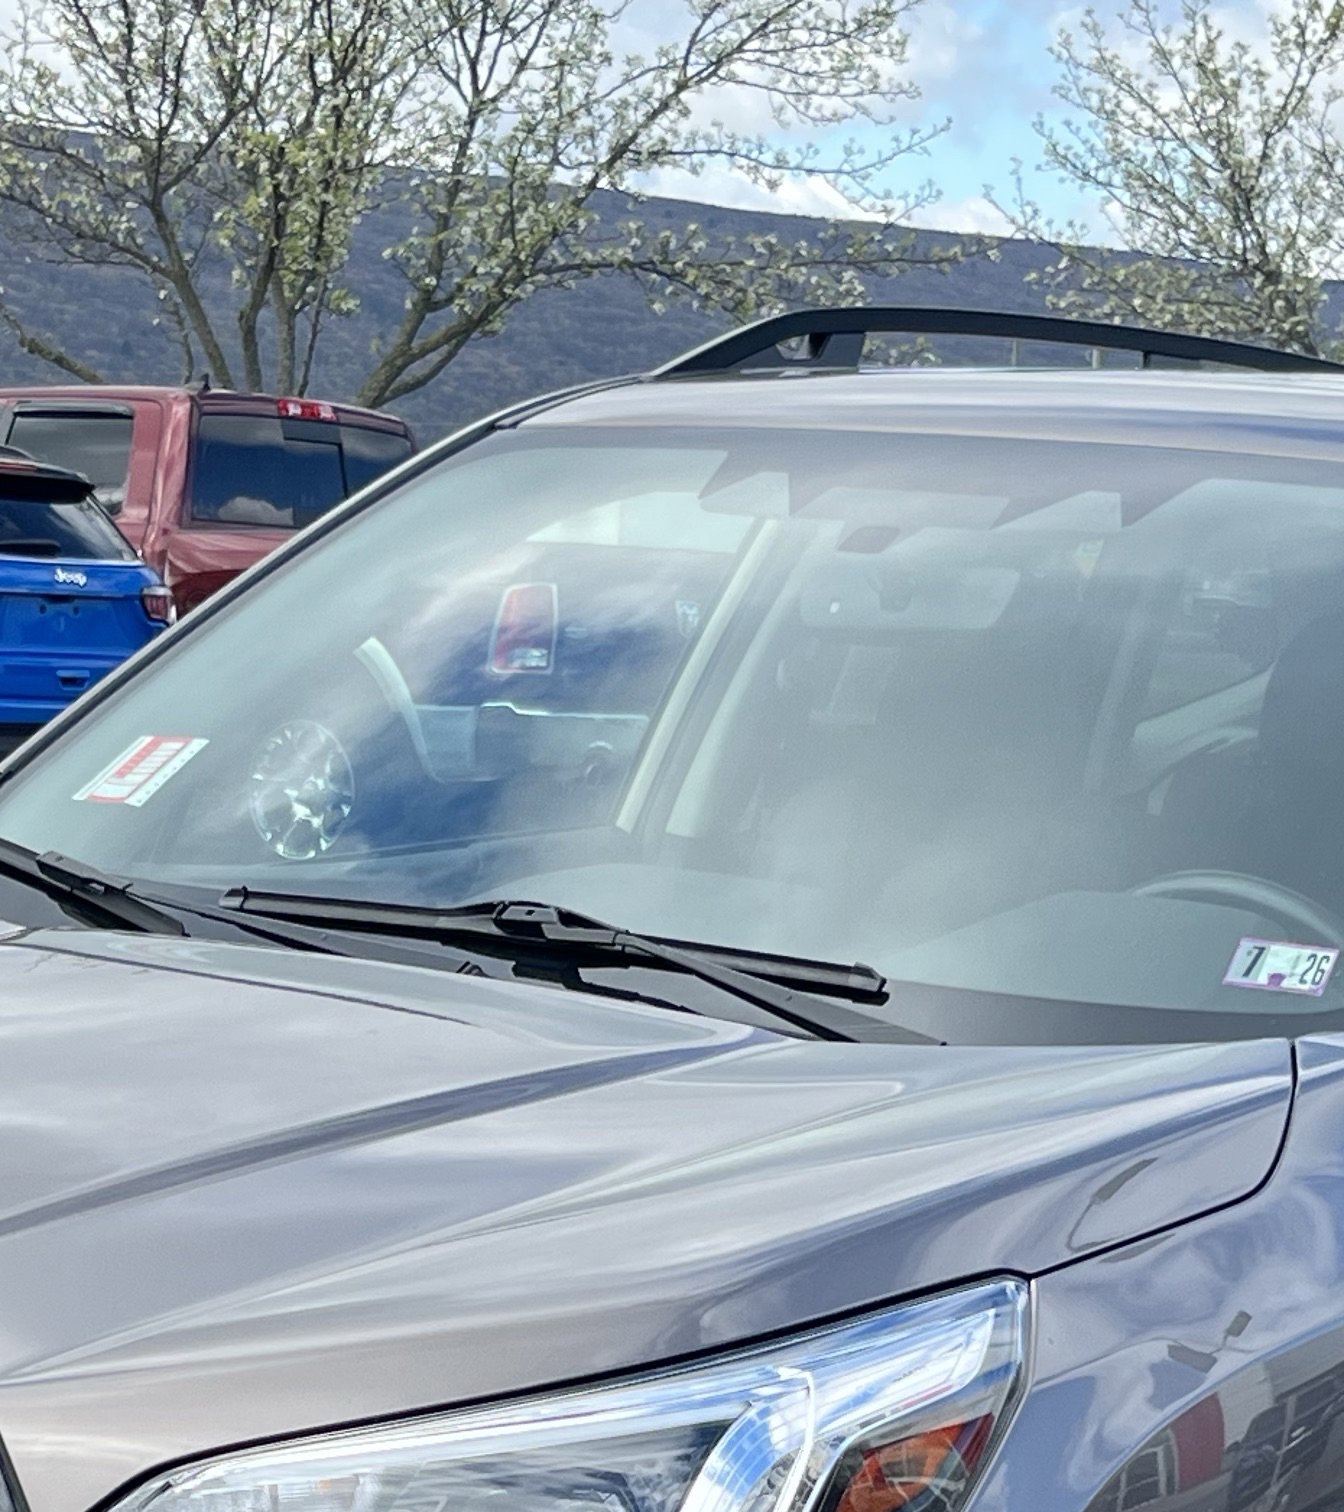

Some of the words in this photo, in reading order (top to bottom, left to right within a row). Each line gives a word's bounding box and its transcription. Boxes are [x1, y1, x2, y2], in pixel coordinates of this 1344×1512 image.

[54, 567, 87, 588] Jeep
[1242, 946, 1267, 977] 7
[1298, 952, 1331, 986] 26
